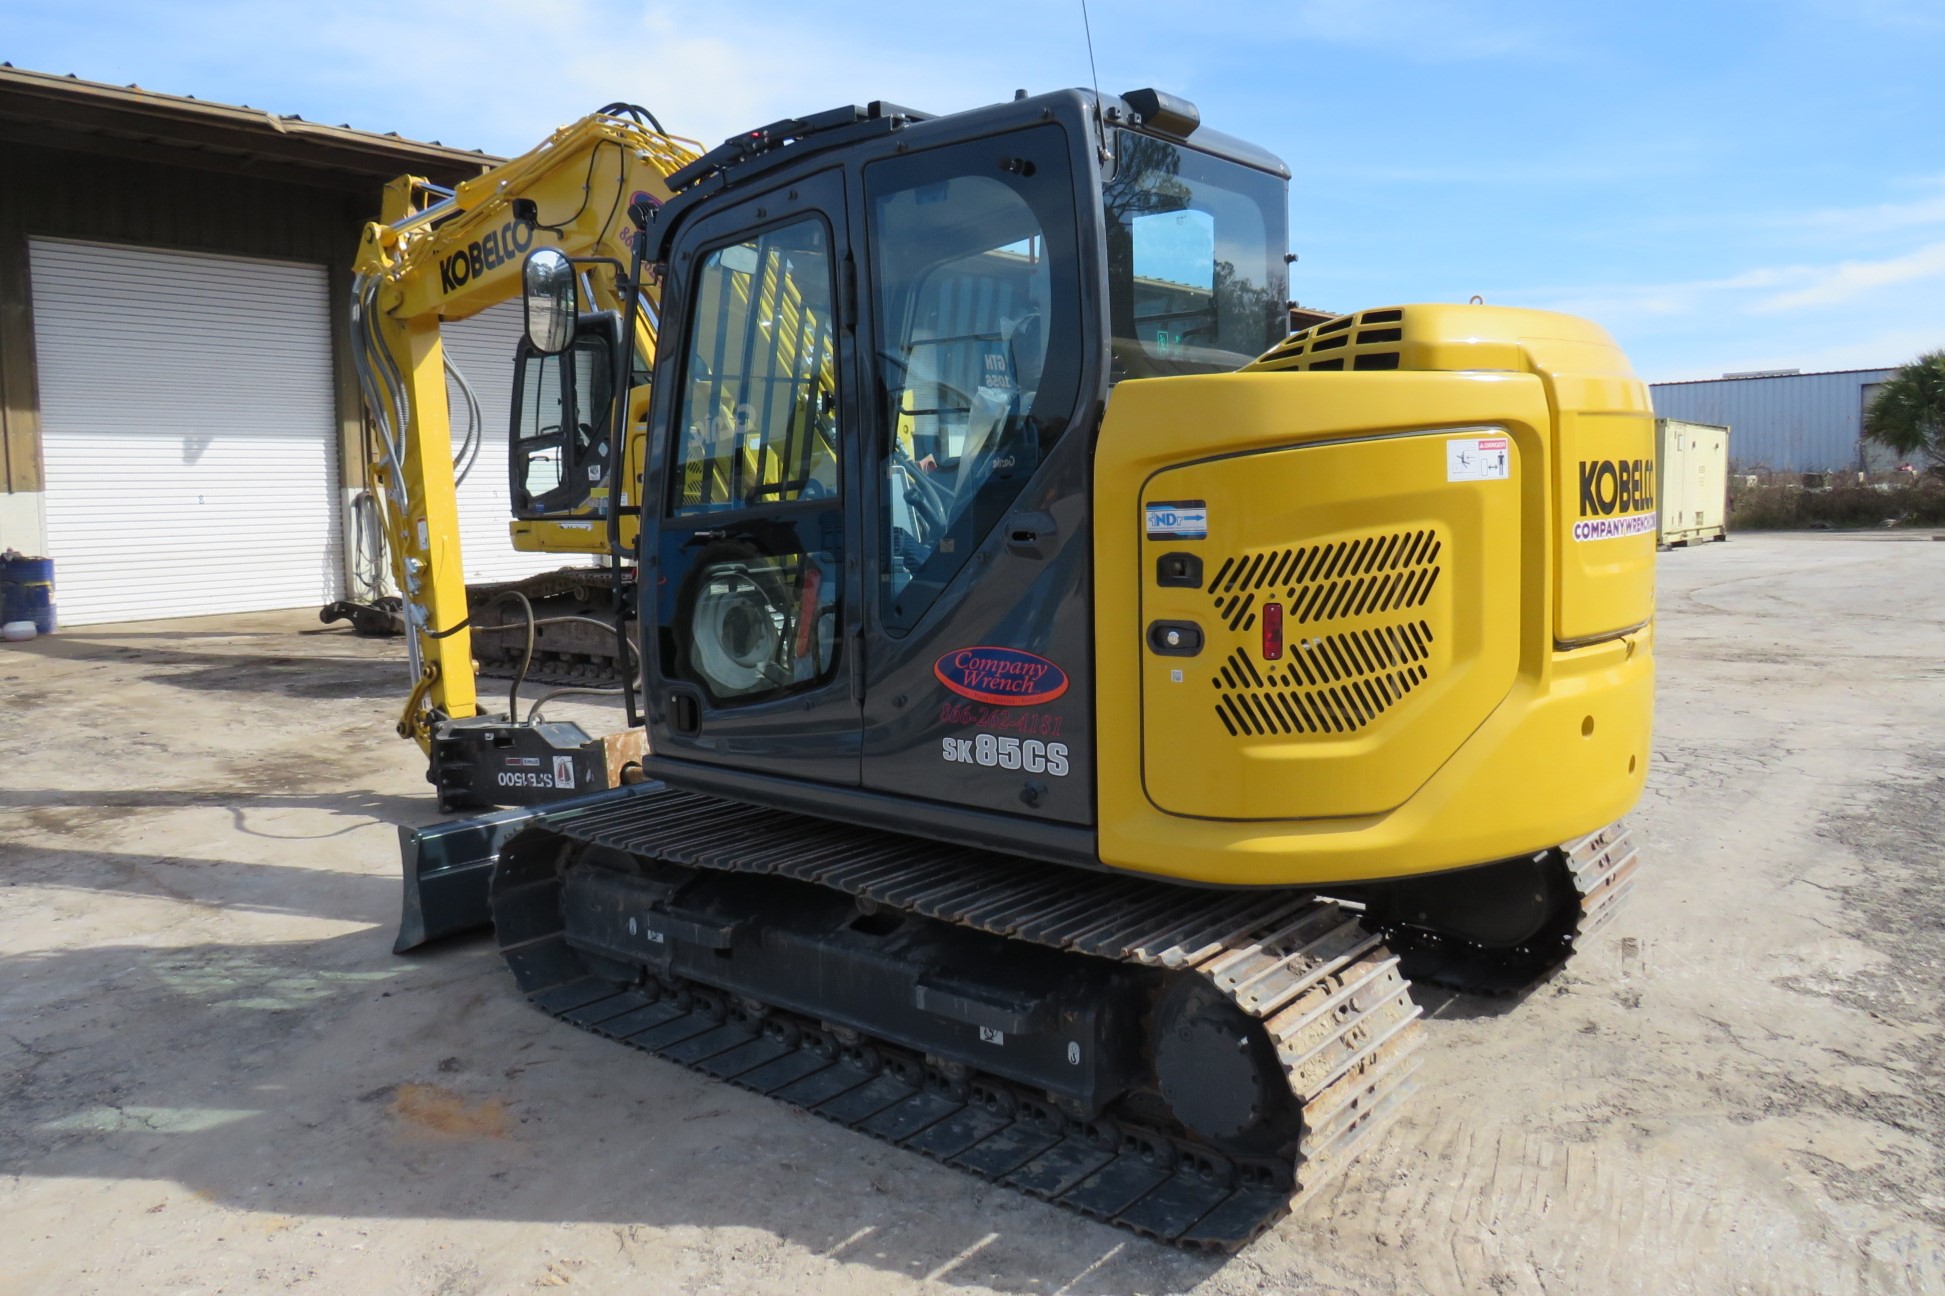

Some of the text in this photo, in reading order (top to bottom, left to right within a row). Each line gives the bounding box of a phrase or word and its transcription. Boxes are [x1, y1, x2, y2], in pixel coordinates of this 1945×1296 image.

[440, 220, 533, 295] KOBELCO
[954, 651, 1048, 680] Company
[963, 669, 1035, 693] Wrench
[940, 702, 1063, 736] 866-262-4181
